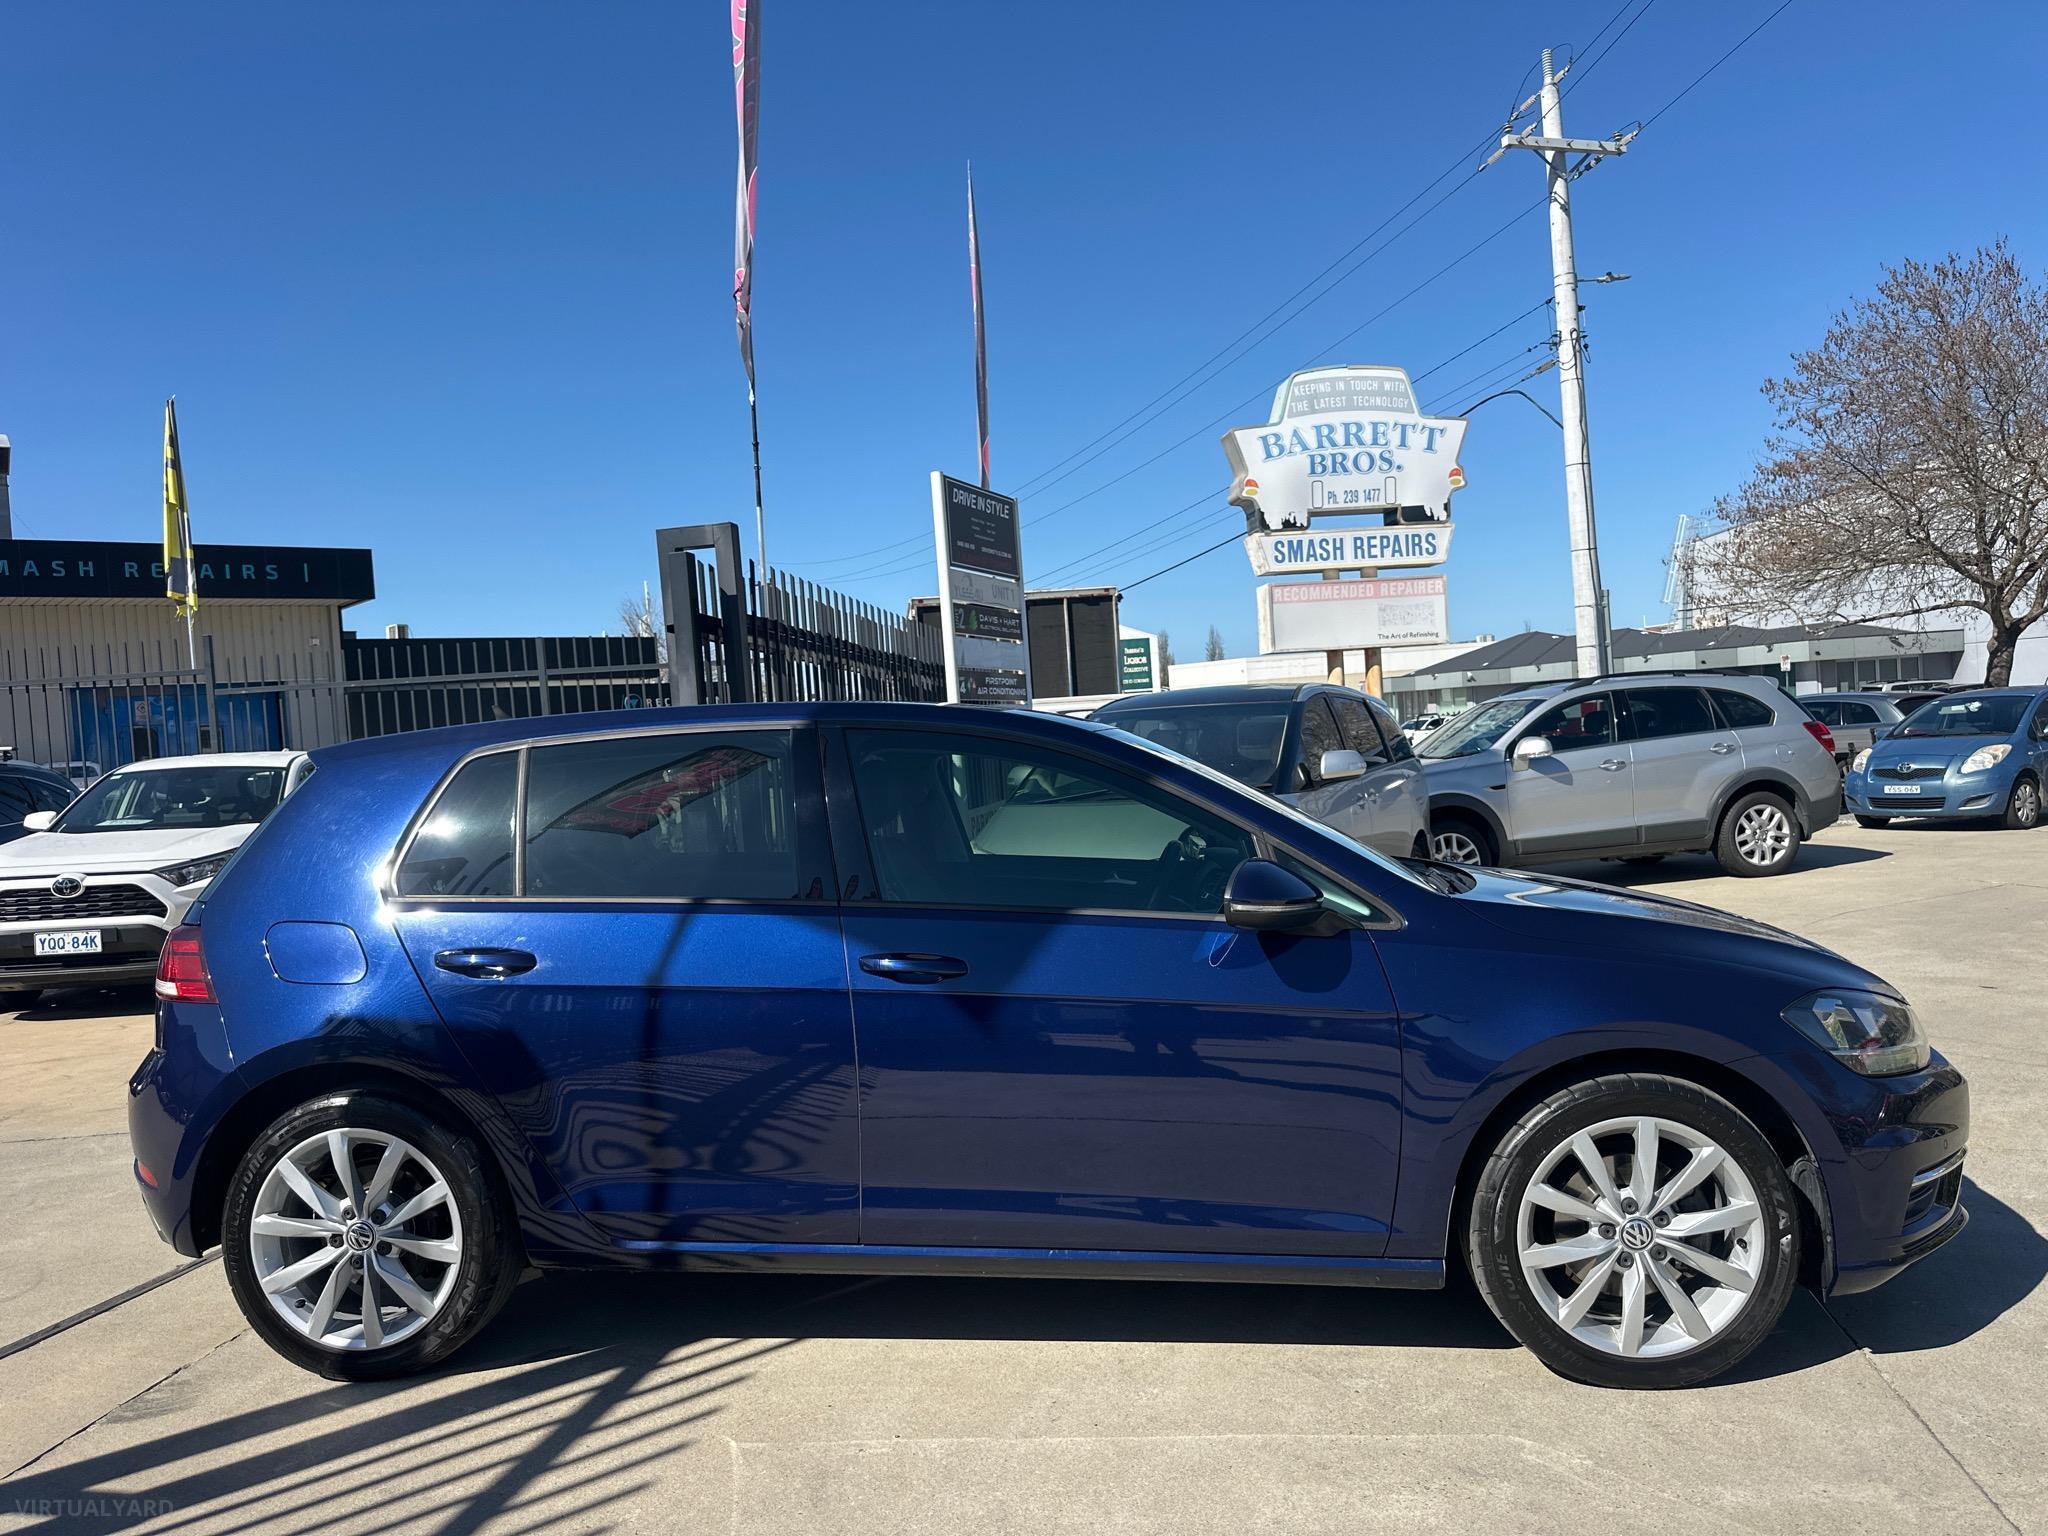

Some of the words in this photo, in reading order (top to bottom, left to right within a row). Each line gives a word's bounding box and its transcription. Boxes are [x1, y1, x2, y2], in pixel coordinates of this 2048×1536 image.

[1294, 382, 1331, 397] KEEPING
[1336, 381, 1345, 391] IN
[1351, 380, 1378, 391] TOUCH
[1383, 381, 1405, 392] WITH
[1291, 401, 1309, 413] THE
[1314, 397, 1346, 409] LATEST
[1353, 396, 1409, 408] TECHNOLOGY
[1258, 421, 1447, 462] BARRETT
[1308, 450, 1403, 476] BROS.
[953, 488, 977, 509] DRIVE
[977, 496, 985, 511] IN
[986, 499, 1010, 519] STYLE
[1343, 490, 1359, 504] 239
[1363, 488, 1381, 503] 1477
[1274, 537, 1344, 564] SMASH
[1353, 532, 1437, 560] REPAIRS
[124, 561, 279, 580] REAIRS
[1273, 583, 1374, 602] RECOMMENDED
[1380, 579, 1444, 597] REPAIRER
[980, 614, 998, 624] DAVIS
[977, 687, 989, 695] AIR
[71, 935, 98, 949] 84K
